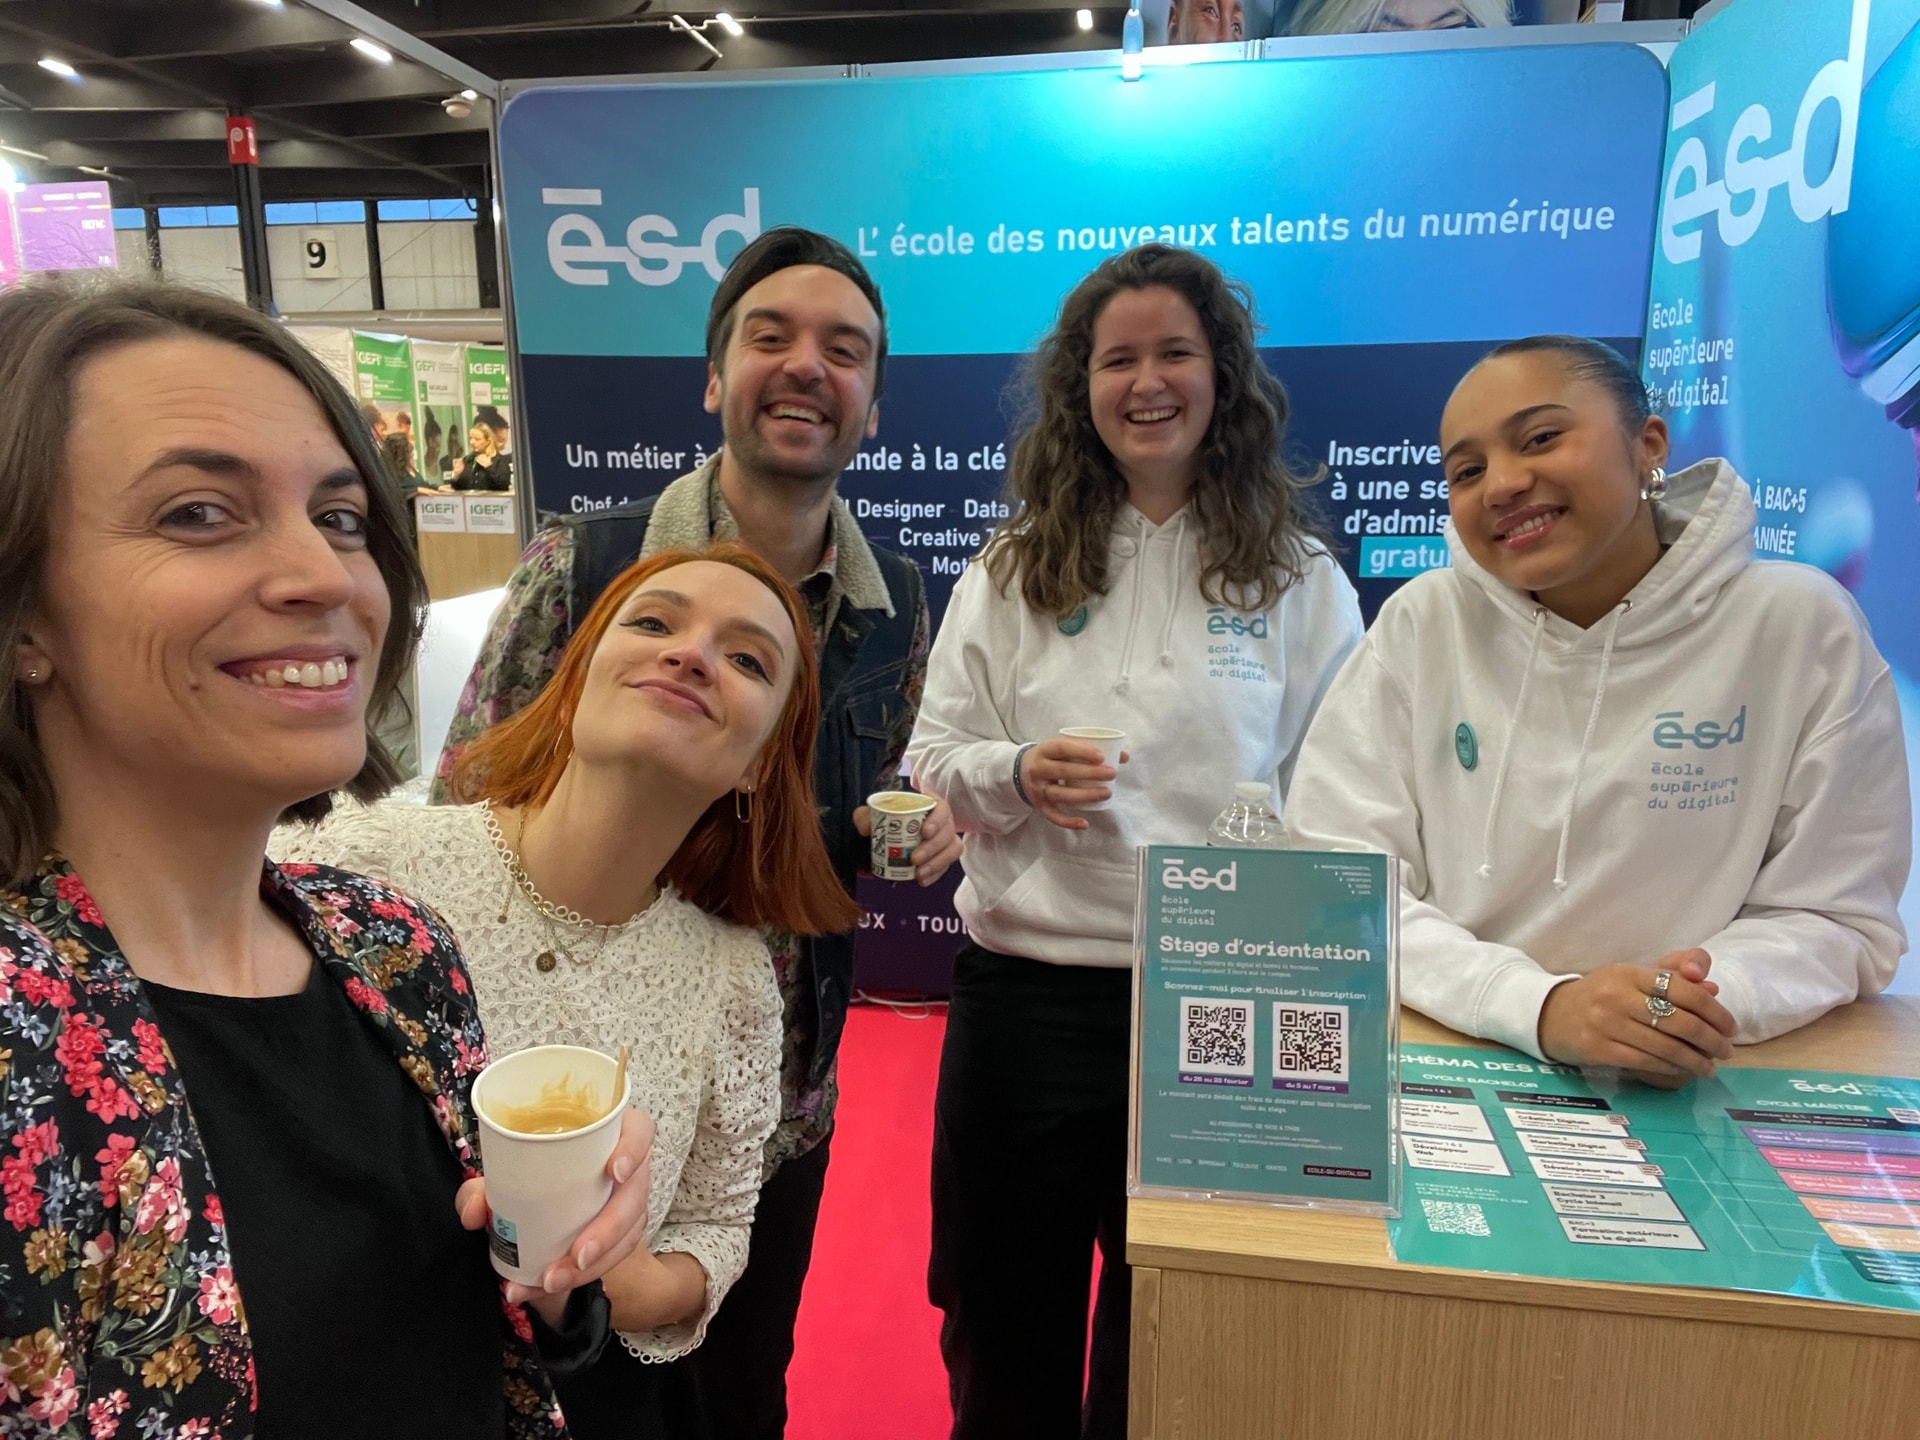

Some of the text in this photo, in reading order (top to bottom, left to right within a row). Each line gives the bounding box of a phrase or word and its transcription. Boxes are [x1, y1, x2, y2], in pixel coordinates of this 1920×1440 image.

[890, 221, 975, 256] école
[987, 223, 1044, 253] des
[1058, 223, 1218, 251] nouveaux
[1231, 213, 1350, 246] talents
[1363, 207, 1406, 240] du
[1419, 198, 1616, 241] numérique
[306, 242, 326, 268] 9
[468, 362, 505, 376] IGEFI
[1668, 376, 1729, 415] digital
[565, 444, 599, 469] Un
[607, 442, 686, 470] métier
[694, 443, 708, 469] à
[911, 443, 926, 471] à
[936, 446, 959, 471] la
[968, 442, 1007, 471] clé
[1328, 439, 1442, 467] Inscrive
[1331, 472, 1347, 501] à
[1358, 480, 1410, 500] une
[422, 503, 455, 515] IGEFI
[1764, 485, 1808, 514] BAC+5
[471, 505, 505, 516] IGEFI
[857, 499, 946, 523] Designer
[964, 499, 1009, 519] Data
[899, 528, 981, 547] Creative
[932, 556, 970, 575] Mot
[1210, 669, 1267, 683] du digital
[1648, 790, 1736, 811] du digital
[1161, 916, 1215, 926] du digital
[1160, 935, 1220, 958] Stage
[1164, 981, 1228, 992] Scannez-moi
[1230, 986, 1253, 995] pour
[1255, 985, 1298, 997] finaliser
[1483, 1061, 1534, 1073] DES
[1423, 1074, 1539, 1088] CYCLE BACHELOR
[1756, 1100, 1802, 1108] CYCLE
[1571, 1226, 1624, 1235] Formation
[1615, 1235, 1648, 1243] digital
